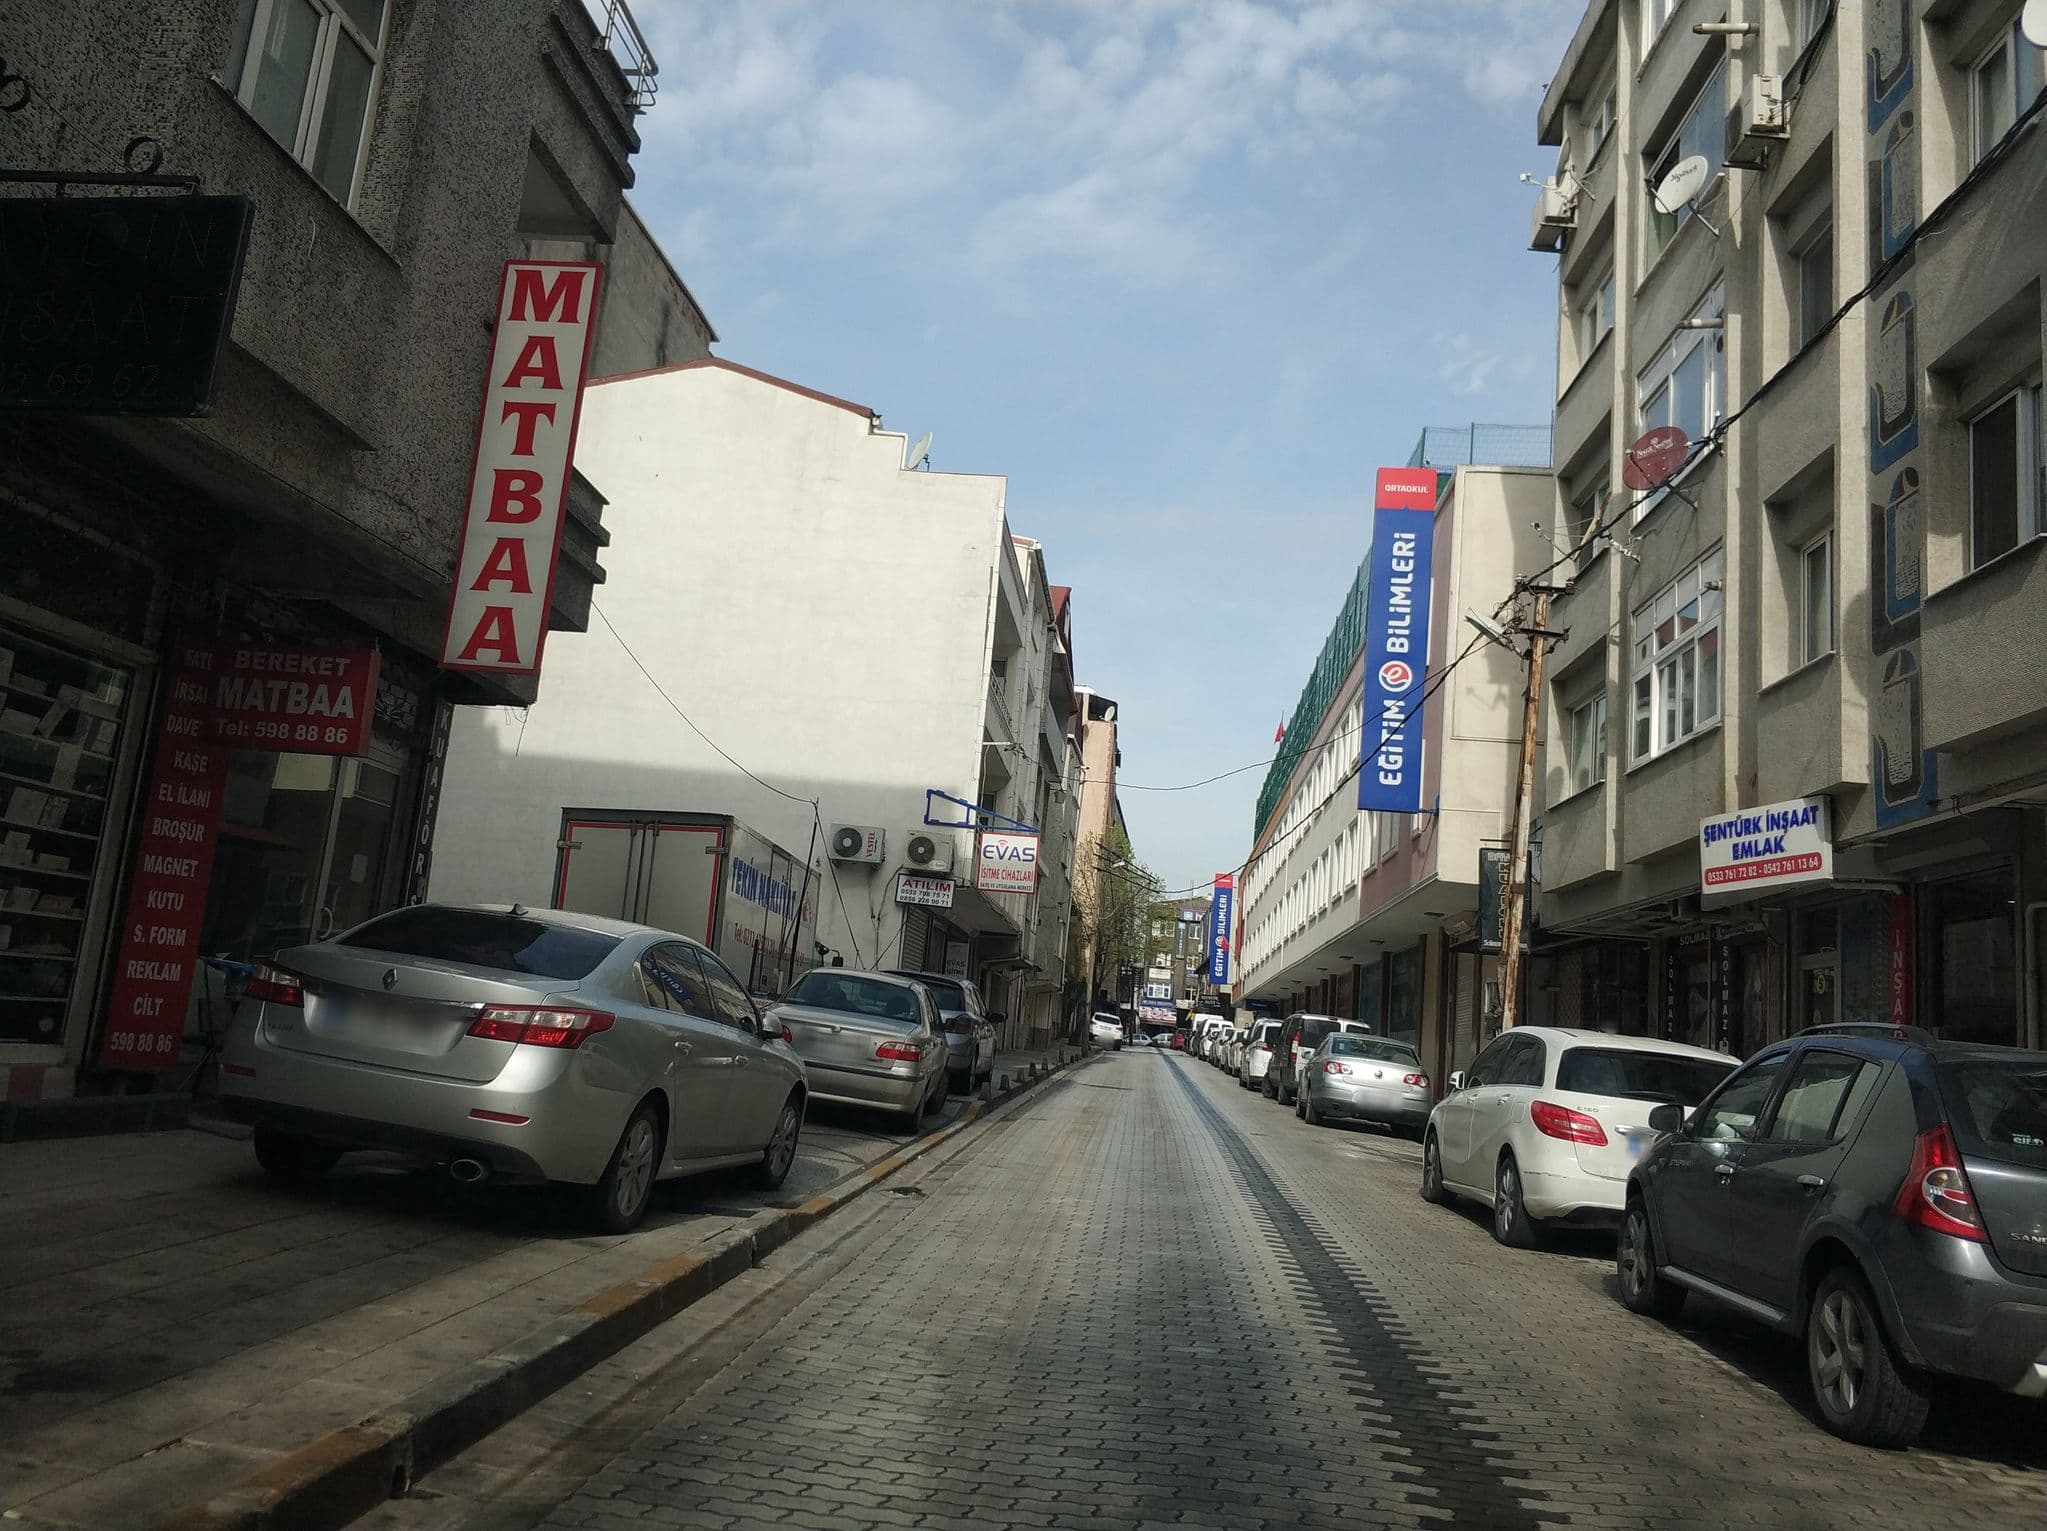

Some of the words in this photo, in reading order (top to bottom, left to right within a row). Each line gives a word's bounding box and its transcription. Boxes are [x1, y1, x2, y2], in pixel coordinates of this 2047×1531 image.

[457, 269, 588, 665] MATBAA
[1384, 484, 1429, 493] ORTAOKUL
[1386, 532, 1416, 653] BİLİMLERİ
[234, 650, 350, 677] BEREKET
[216, 677, 354, 720] MATBAA
[216, 718, 249, 737] Tel:
[254, 721, 290, 739] 598
[295, 725, 319, 741] 88
[324, 726, 349, 744] 86
[1377, 699, 1406, 785] EĞİTİM
[173, 752, 209, 776] KAŞE
[159, 782, 176, 802] EL
[177, 782, 211, 809] İLANI
[151, 817, 205, 844] BROŞÜR
[1703, 814, 1762, 848] ŞENTÜRK
[1766, 805, 1819, 834] İNŞAAT
[982, 844, 1036, 862] EVAS
[1732, 835, 1785, 861] EMLAK
[144, 854, 200, 879] MAGNET
[1707, 870, 1724, 883] 0533
[1725, 869, 1736, 880] 761
[1739, 867, 1747, 878] 72
[1748, 866, 1758, 876] 82
[1763, 863, 1781, 874] 0542
[1782, 859, 1795, 872] 761
[1798, 858, 1807, 869] 13
[1808, 856, 1819, 868] 64
[147, 890, 185, 912] KUTU
[133, 924, 145, 944] S.
[150, 925, 187, 947] FORM
[126, 959, 182, 982] REKLAM
[132, 993, 164, 1017] CİLT
[110, 1031, 136, 1051] 598
[137, 1033, 154, 1052] 88
[156, 1035, 173, 1054] 86
